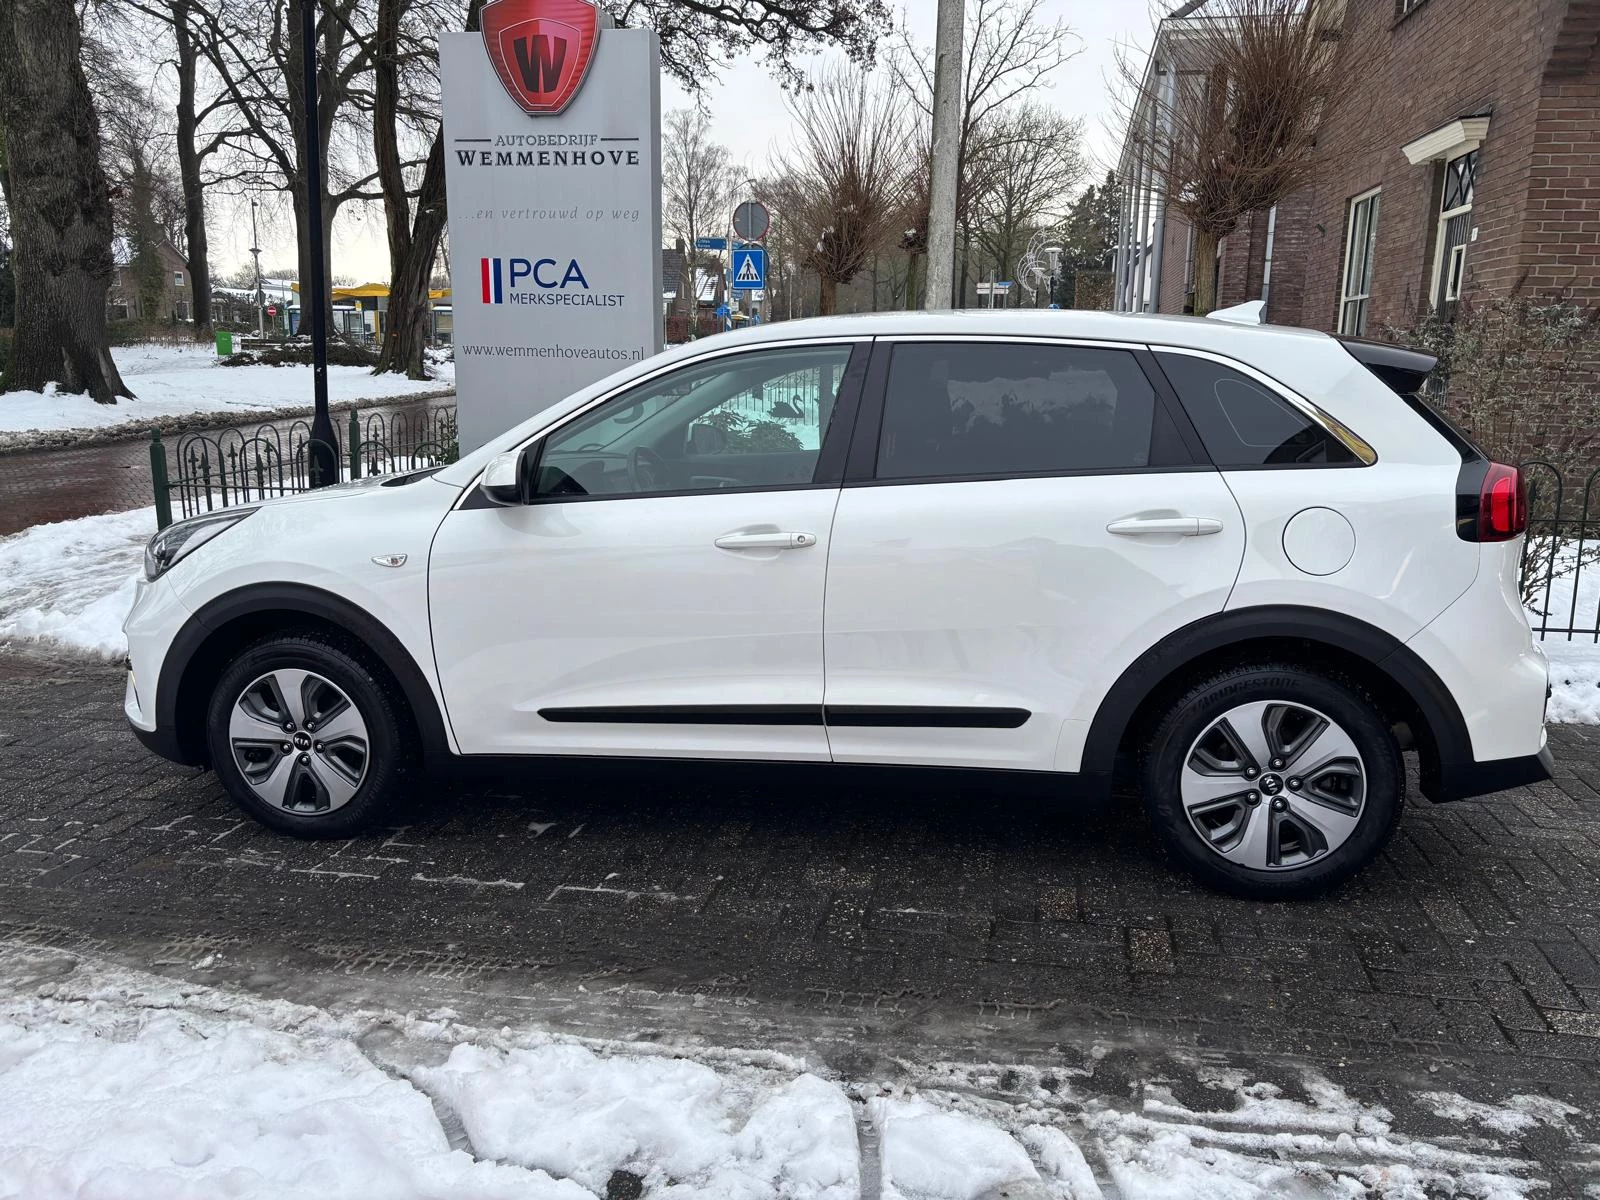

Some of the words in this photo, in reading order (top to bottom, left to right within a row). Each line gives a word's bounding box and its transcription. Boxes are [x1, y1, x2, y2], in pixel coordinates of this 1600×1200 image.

[513, 34, 568, 94] W
[495, 134, 598, 147] AUTOBEDRIJF
[455, 150, 640, 167] WEMMENHOVE
[502, 206, 578, 220] vertrouwd
[586, 208, 604, 222] op
[612, 208, 640, 222] weg
[509, 258, 589, 289] PCA
[509, 293, 625, 307] MERKSPECIALIST
[462, 344, 645, 361] www.wemmenhoveautos.nl
[294, 736, 310, 746] KIA
[1264, 775, 1279, 795] KIA
